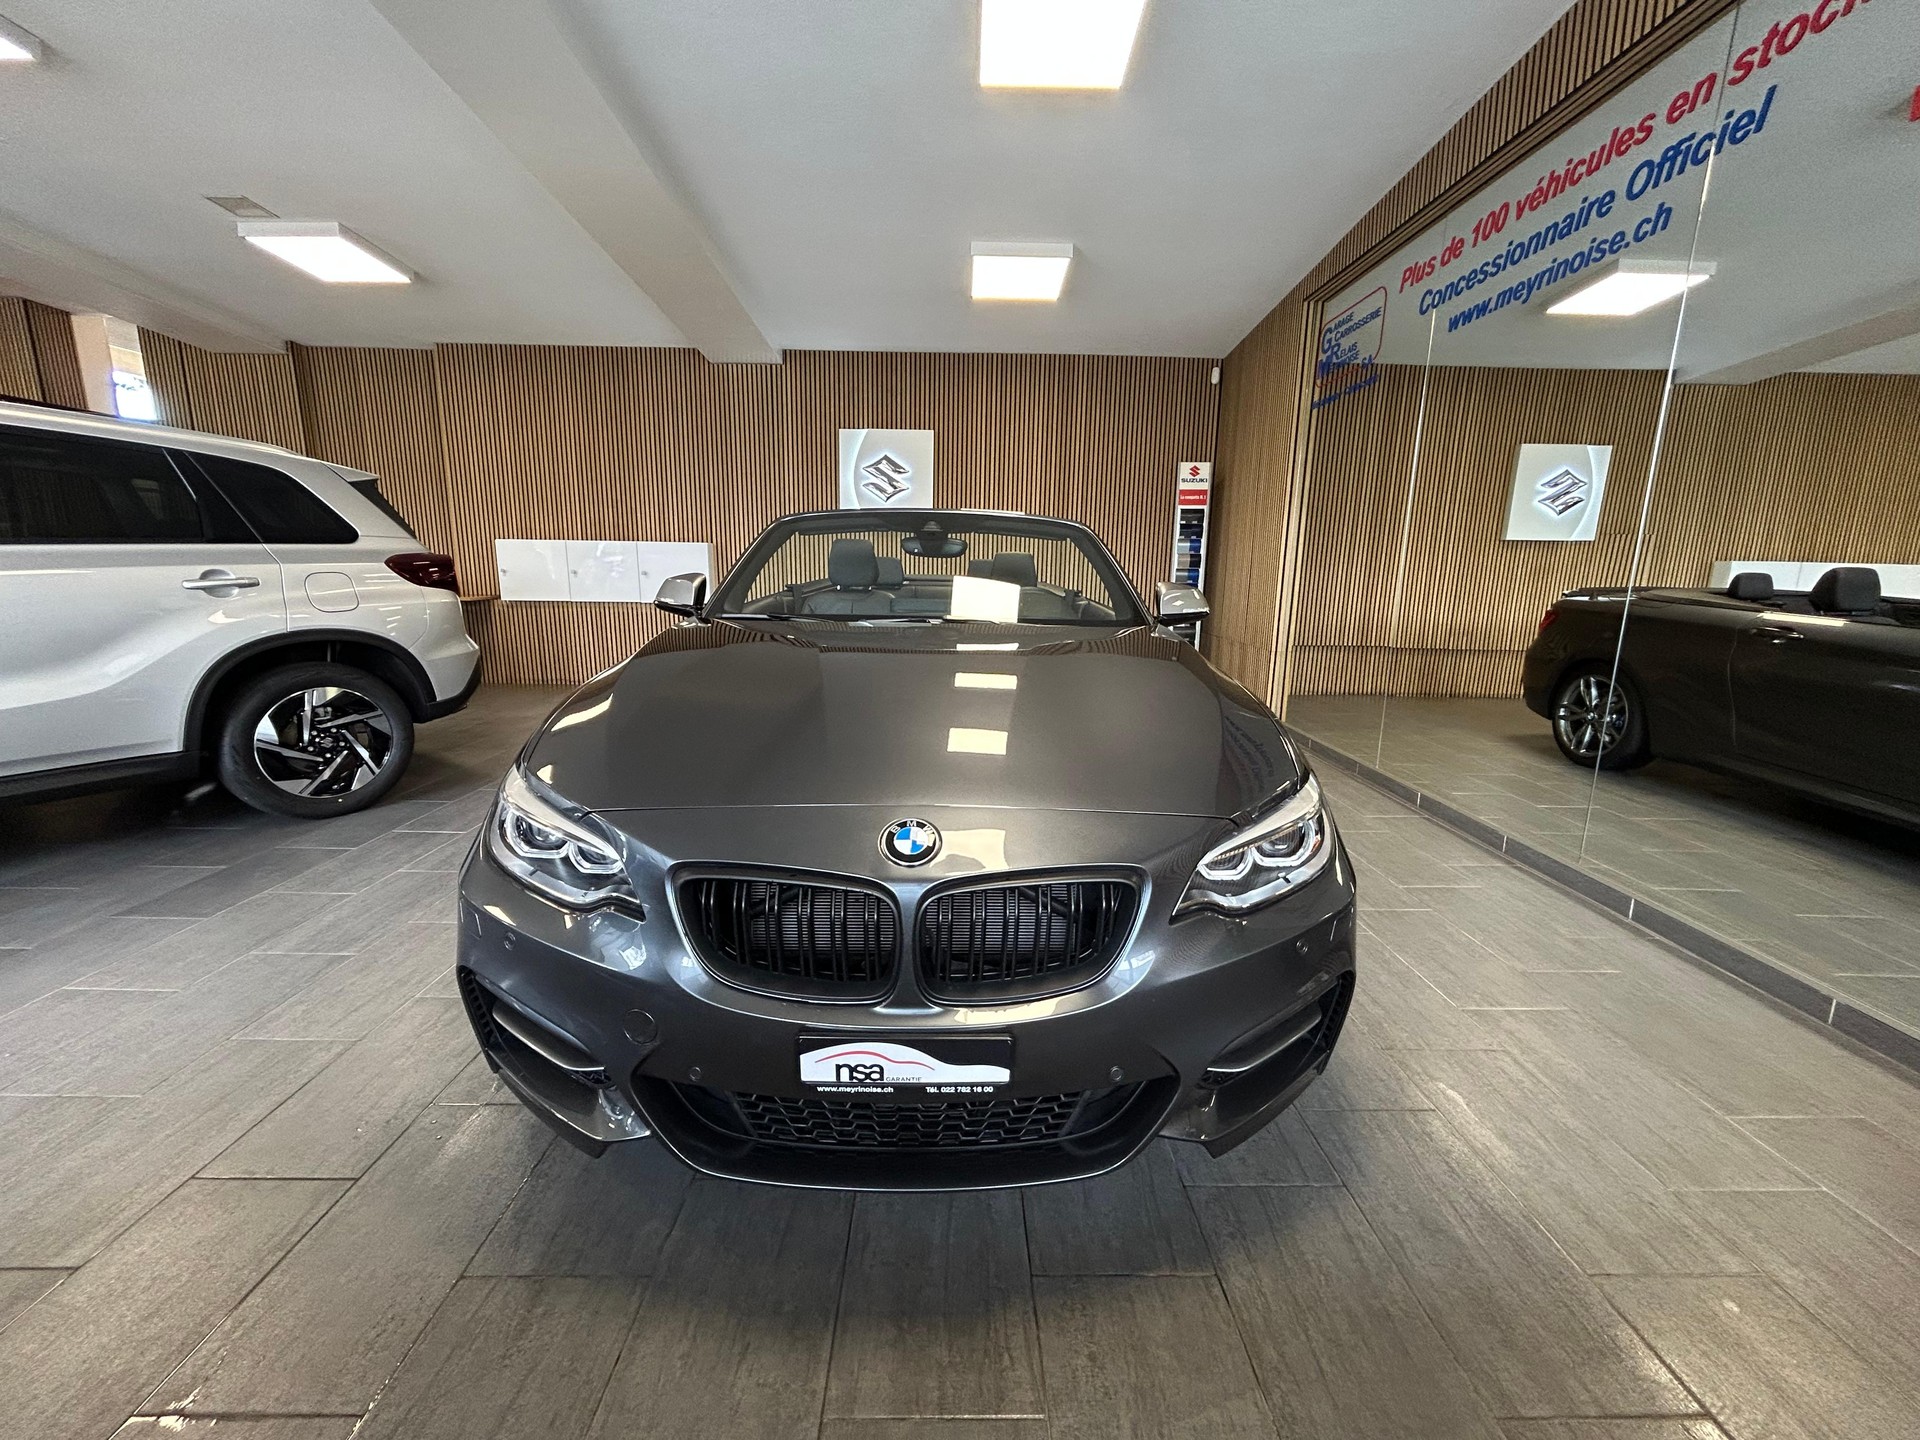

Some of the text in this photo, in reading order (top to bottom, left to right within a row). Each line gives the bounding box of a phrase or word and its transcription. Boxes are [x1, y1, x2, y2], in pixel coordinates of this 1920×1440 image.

[1399, 255, 1437, 294] Plus
[1439, 236, 1465, 267] de
[1472, 201, 1510, 248] 100
[1516, 112, 1656, 221] véhicules
[1666, 72, 1718, 124] en
[1418, 84, 1778, 316] Concessionnaire Officiel
[1448, 201, 1673, 332] www.meyrinoise.ch
[890, 820, 935, 834] BMW
[835, 1063, 884, 1082] nsa
